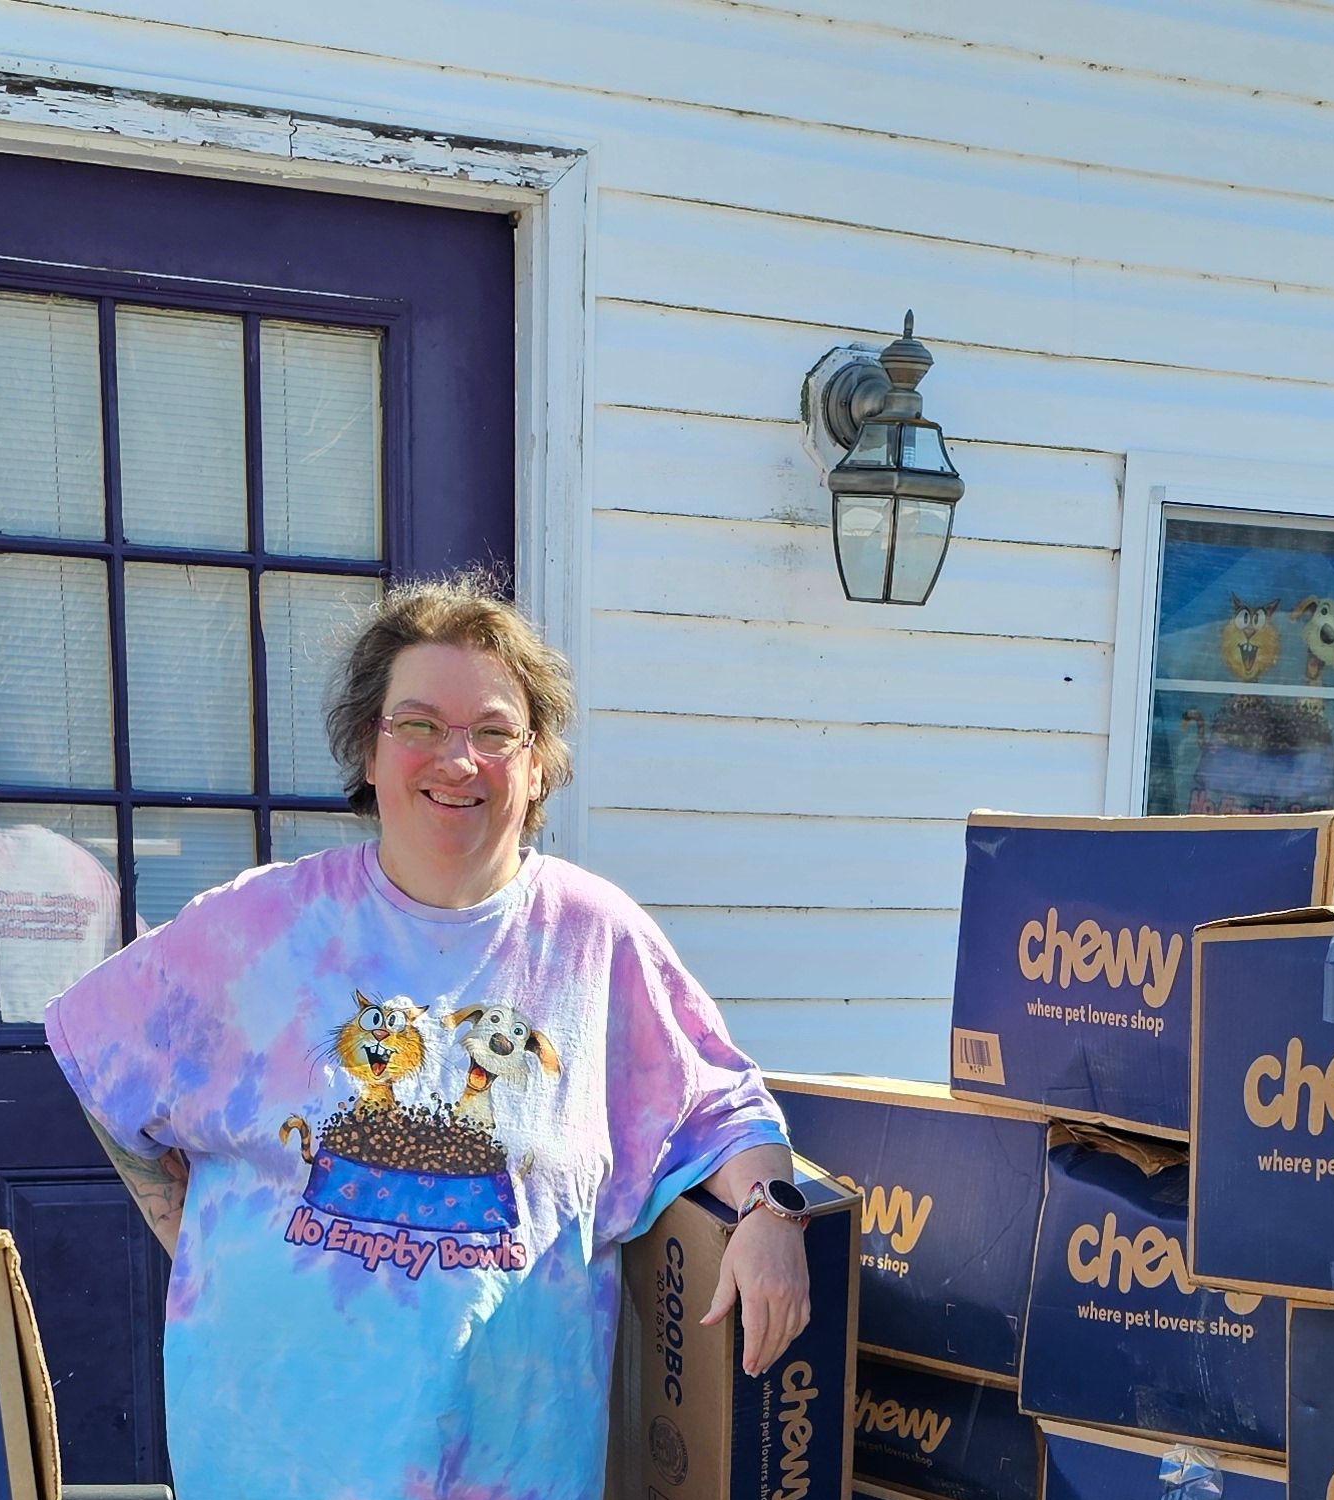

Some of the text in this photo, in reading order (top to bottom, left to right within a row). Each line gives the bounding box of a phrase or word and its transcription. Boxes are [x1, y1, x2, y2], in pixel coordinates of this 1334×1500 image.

[1019, 907, 1183, 1009] chewy
[1027, 998, 1164, 1038] where pet lovers shop
[1258, 1149, 1312, 1173] where
[284, 1206, 528, 1280] No Empty Bowls
[656, 1270, 665, 1292] 20
[877, 1253, 909, 1278] shop
[665, 1236, 684, 1407] C200BC
[1078, 1301, 1255, 1343] where pet lovers shop
[762, 1380, 774, 1418] where
[760, 1422, 772, 1443] pet
[761, 1444, 772, 1481] lovers
